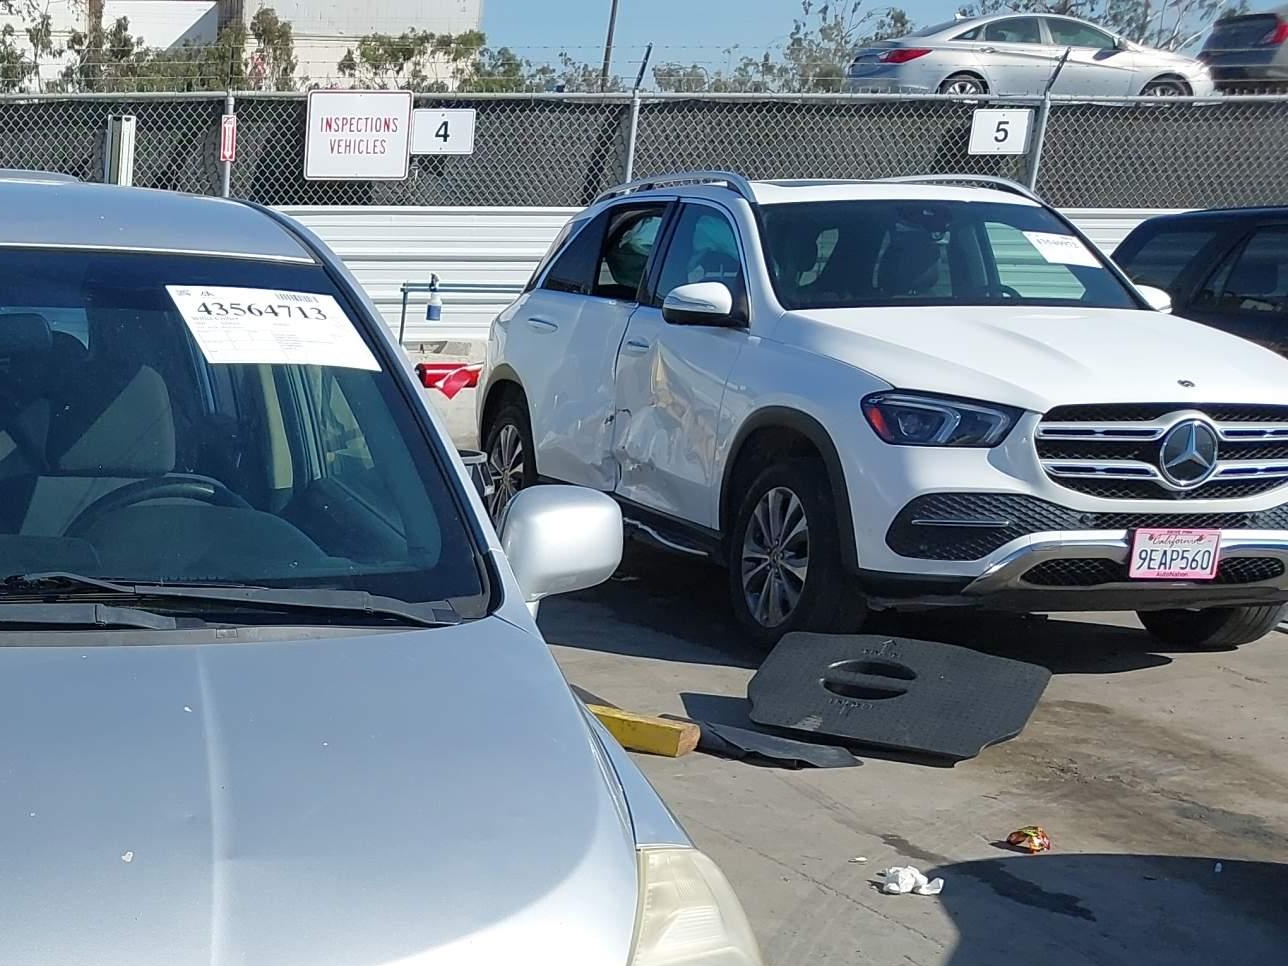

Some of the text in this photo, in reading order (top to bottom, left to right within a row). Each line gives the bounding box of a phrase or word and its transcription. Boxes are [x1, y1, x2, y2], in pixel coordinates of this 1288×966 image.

[320, 116, 399, 133] INSPECTIONS
[434, 120, 451, 143] 4
[994, 121, 1010, 143] 5
[329, 139, 387, 155] VEHICLES
[197, 302, 328, 321] 43564713
[1136, 548, 1212, 571] 9EAP560
